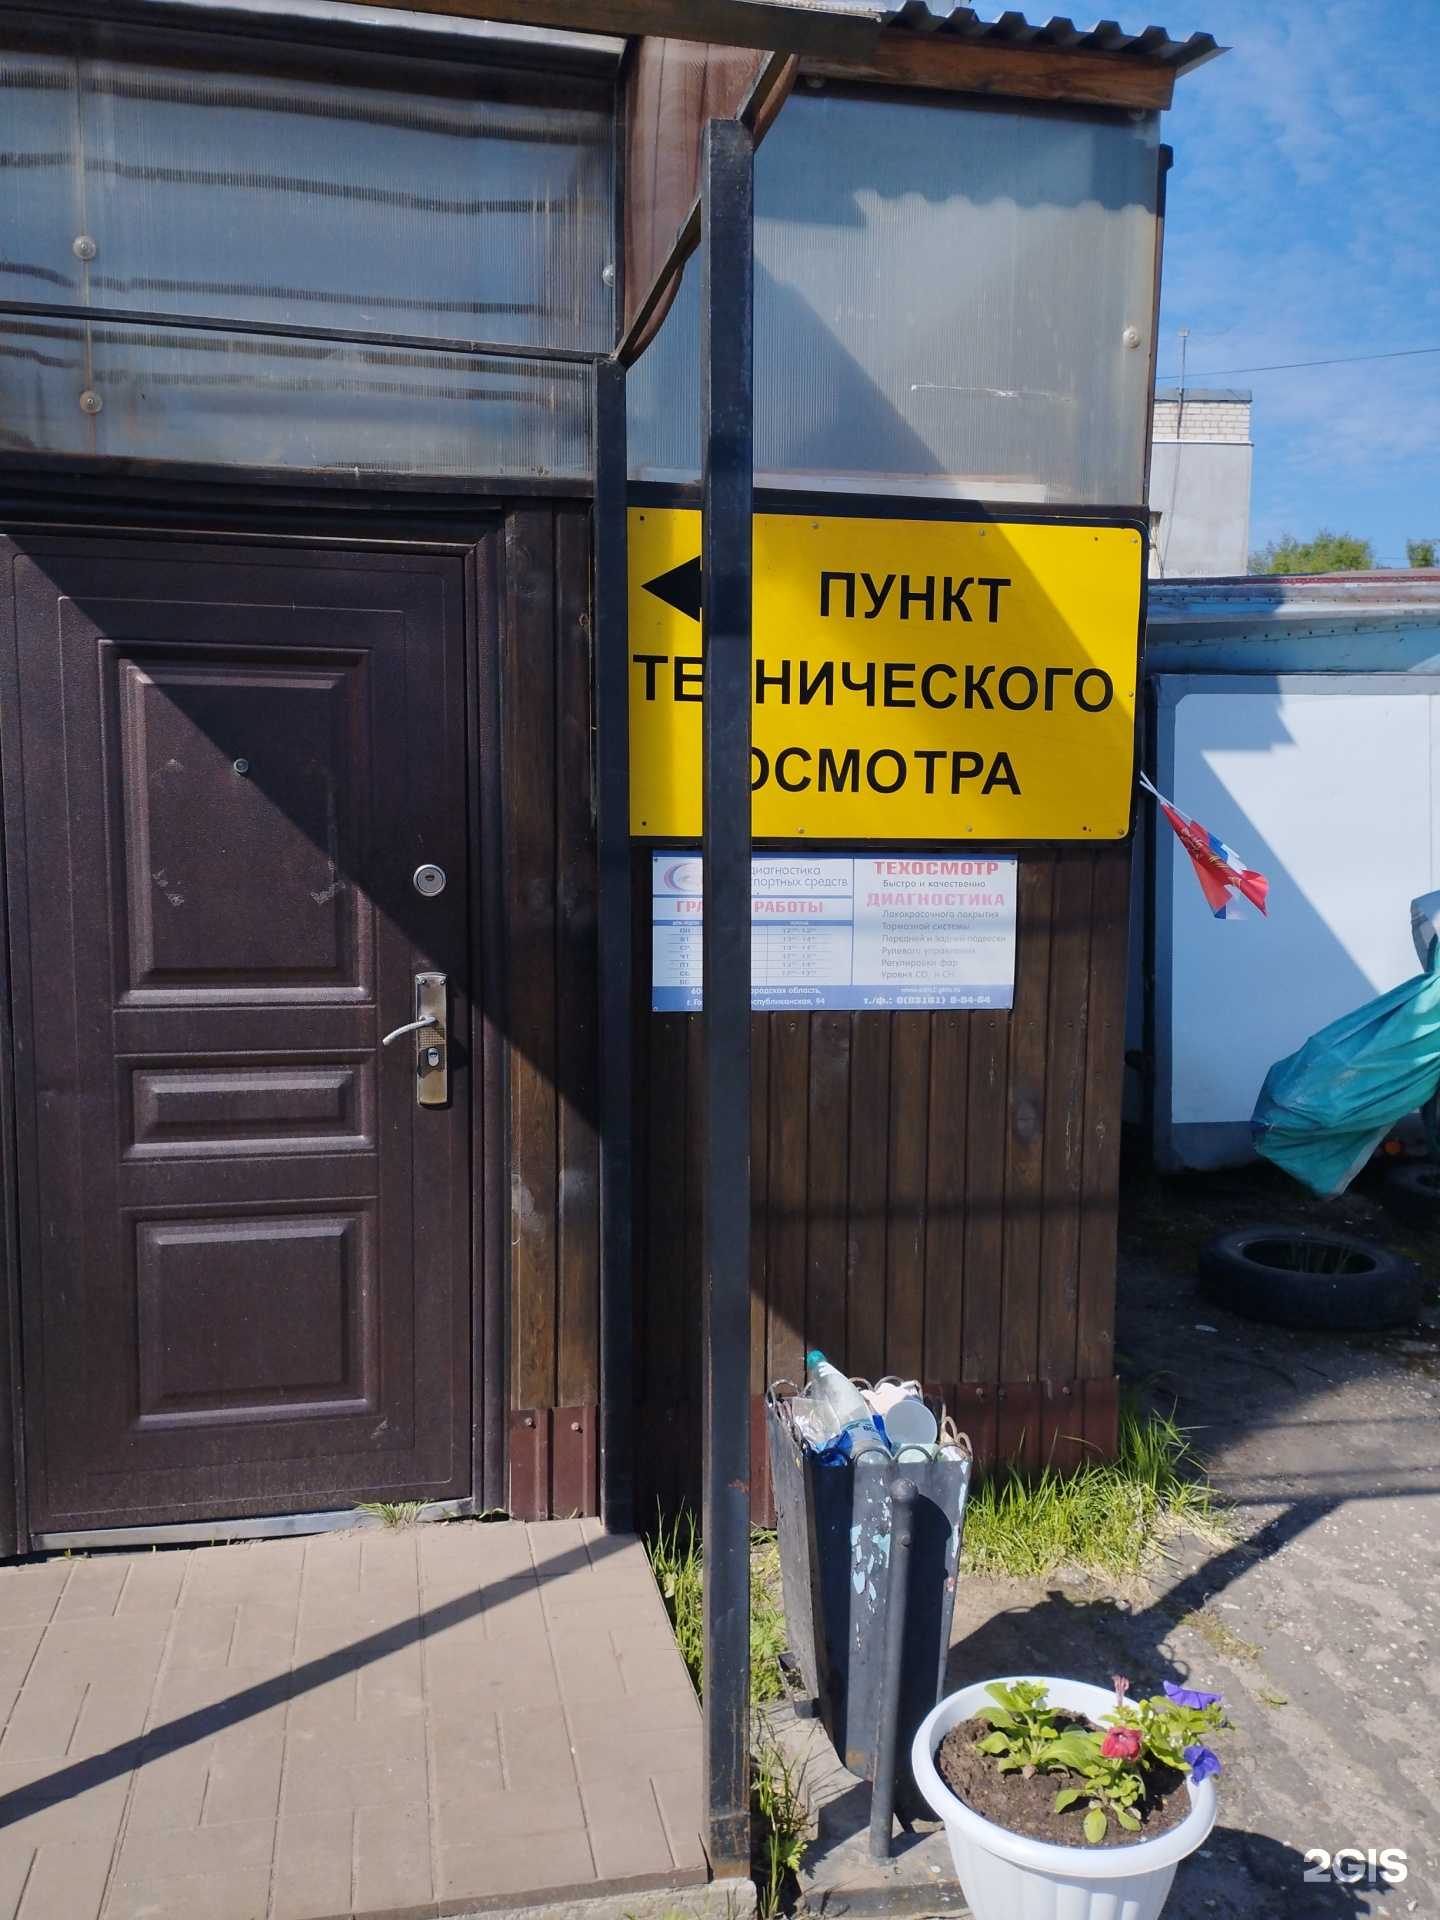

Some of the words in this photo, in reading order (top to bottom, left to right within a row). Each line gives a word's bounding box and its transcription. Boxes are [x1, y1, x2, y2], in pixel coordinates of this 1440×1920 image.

[818, 571, 1012, 623] ПУНКТ
[633, 655, 1114, 713] ТЕНИЧЕСКОГО
[873, 861, 999, 876] ТЕХОСМОТР
[753, 878, 802, 889] портных
[804, 878, 849, 889] средств
[883, 880, 917, 890] Быстро
[928, 881, 986, 889] качественно
[755, 901, 823, 913] РАБОТЫ
[866, 893, 1006, 907] ДИАГНОСТИКА
